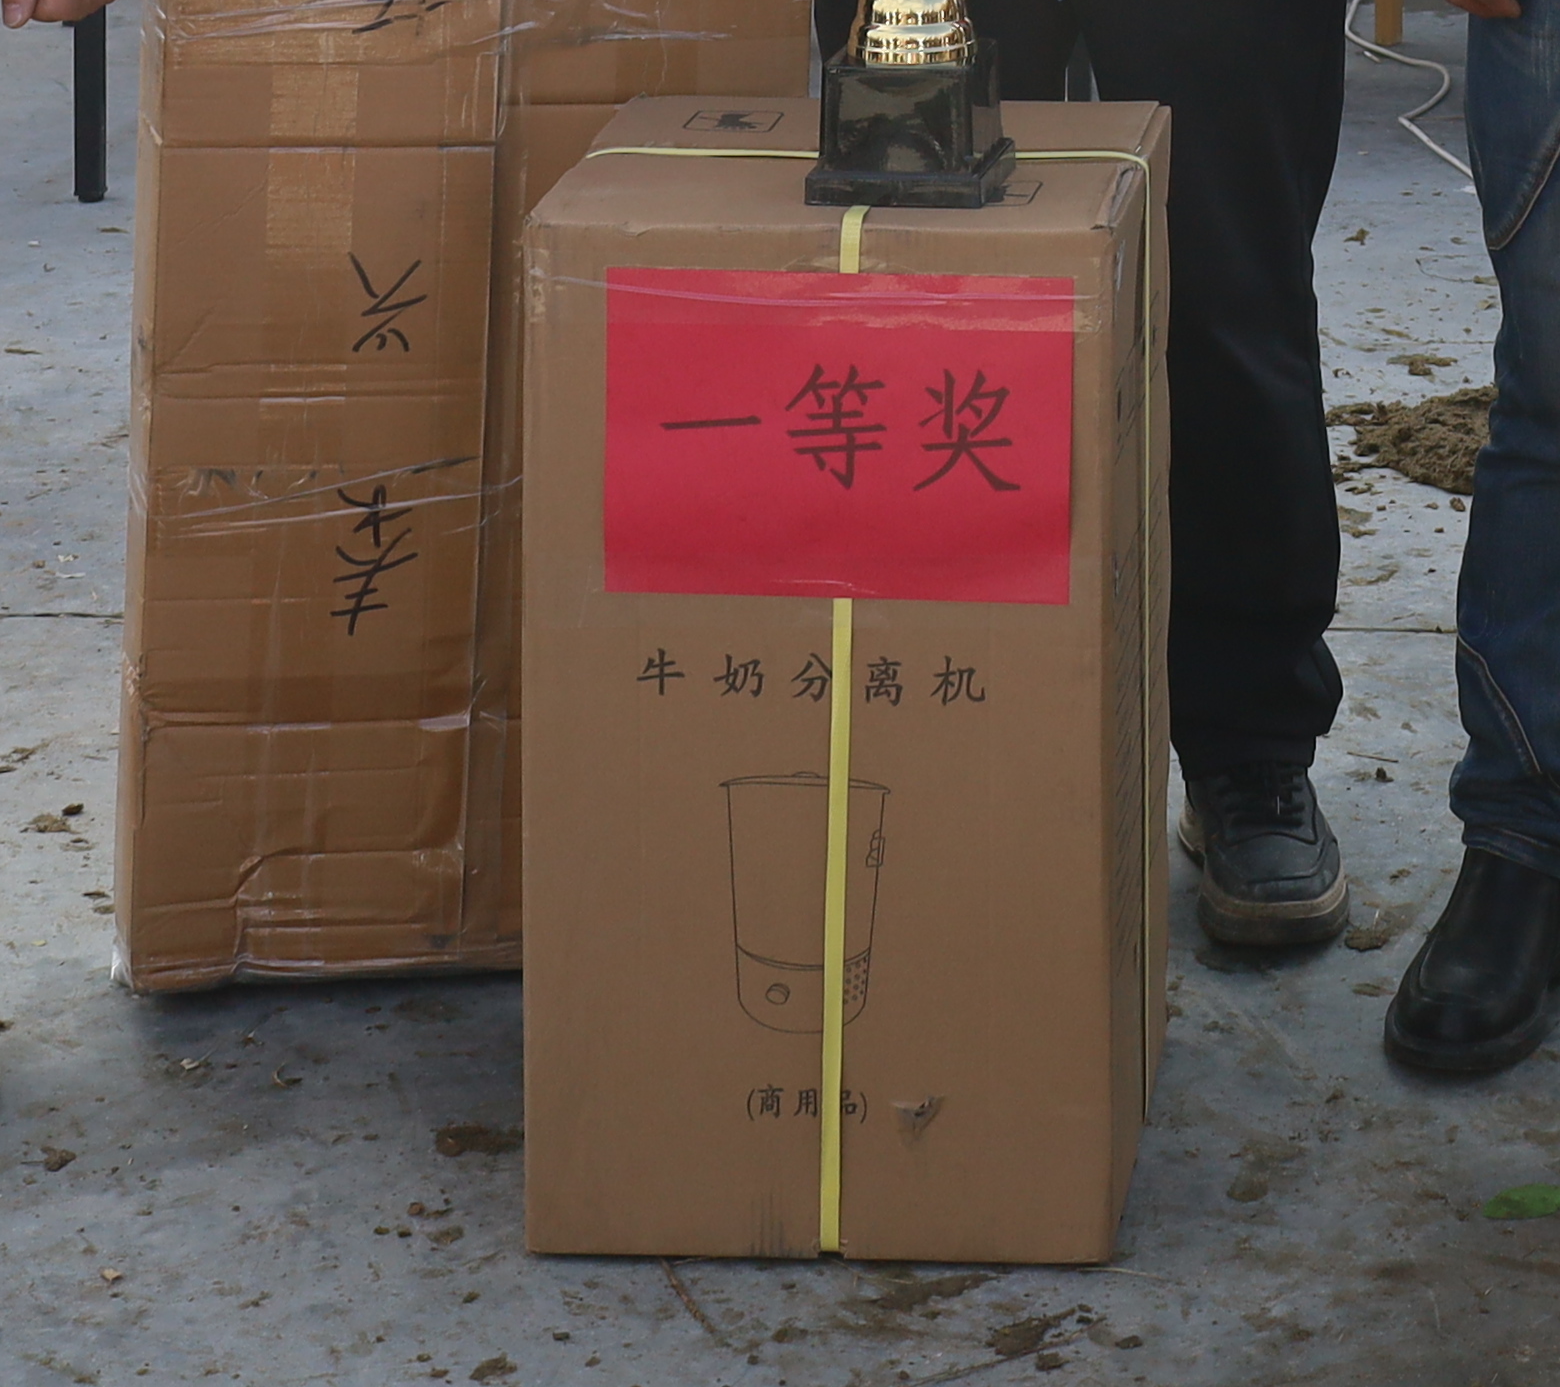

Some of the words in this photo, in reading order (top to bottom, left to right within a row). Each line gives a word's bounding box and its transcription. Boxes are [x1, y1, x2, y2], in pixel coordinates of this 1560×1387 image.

[659, 362, 1022, 494] 一等奖
[635, 647, 987, 707] 牛奶分离机
